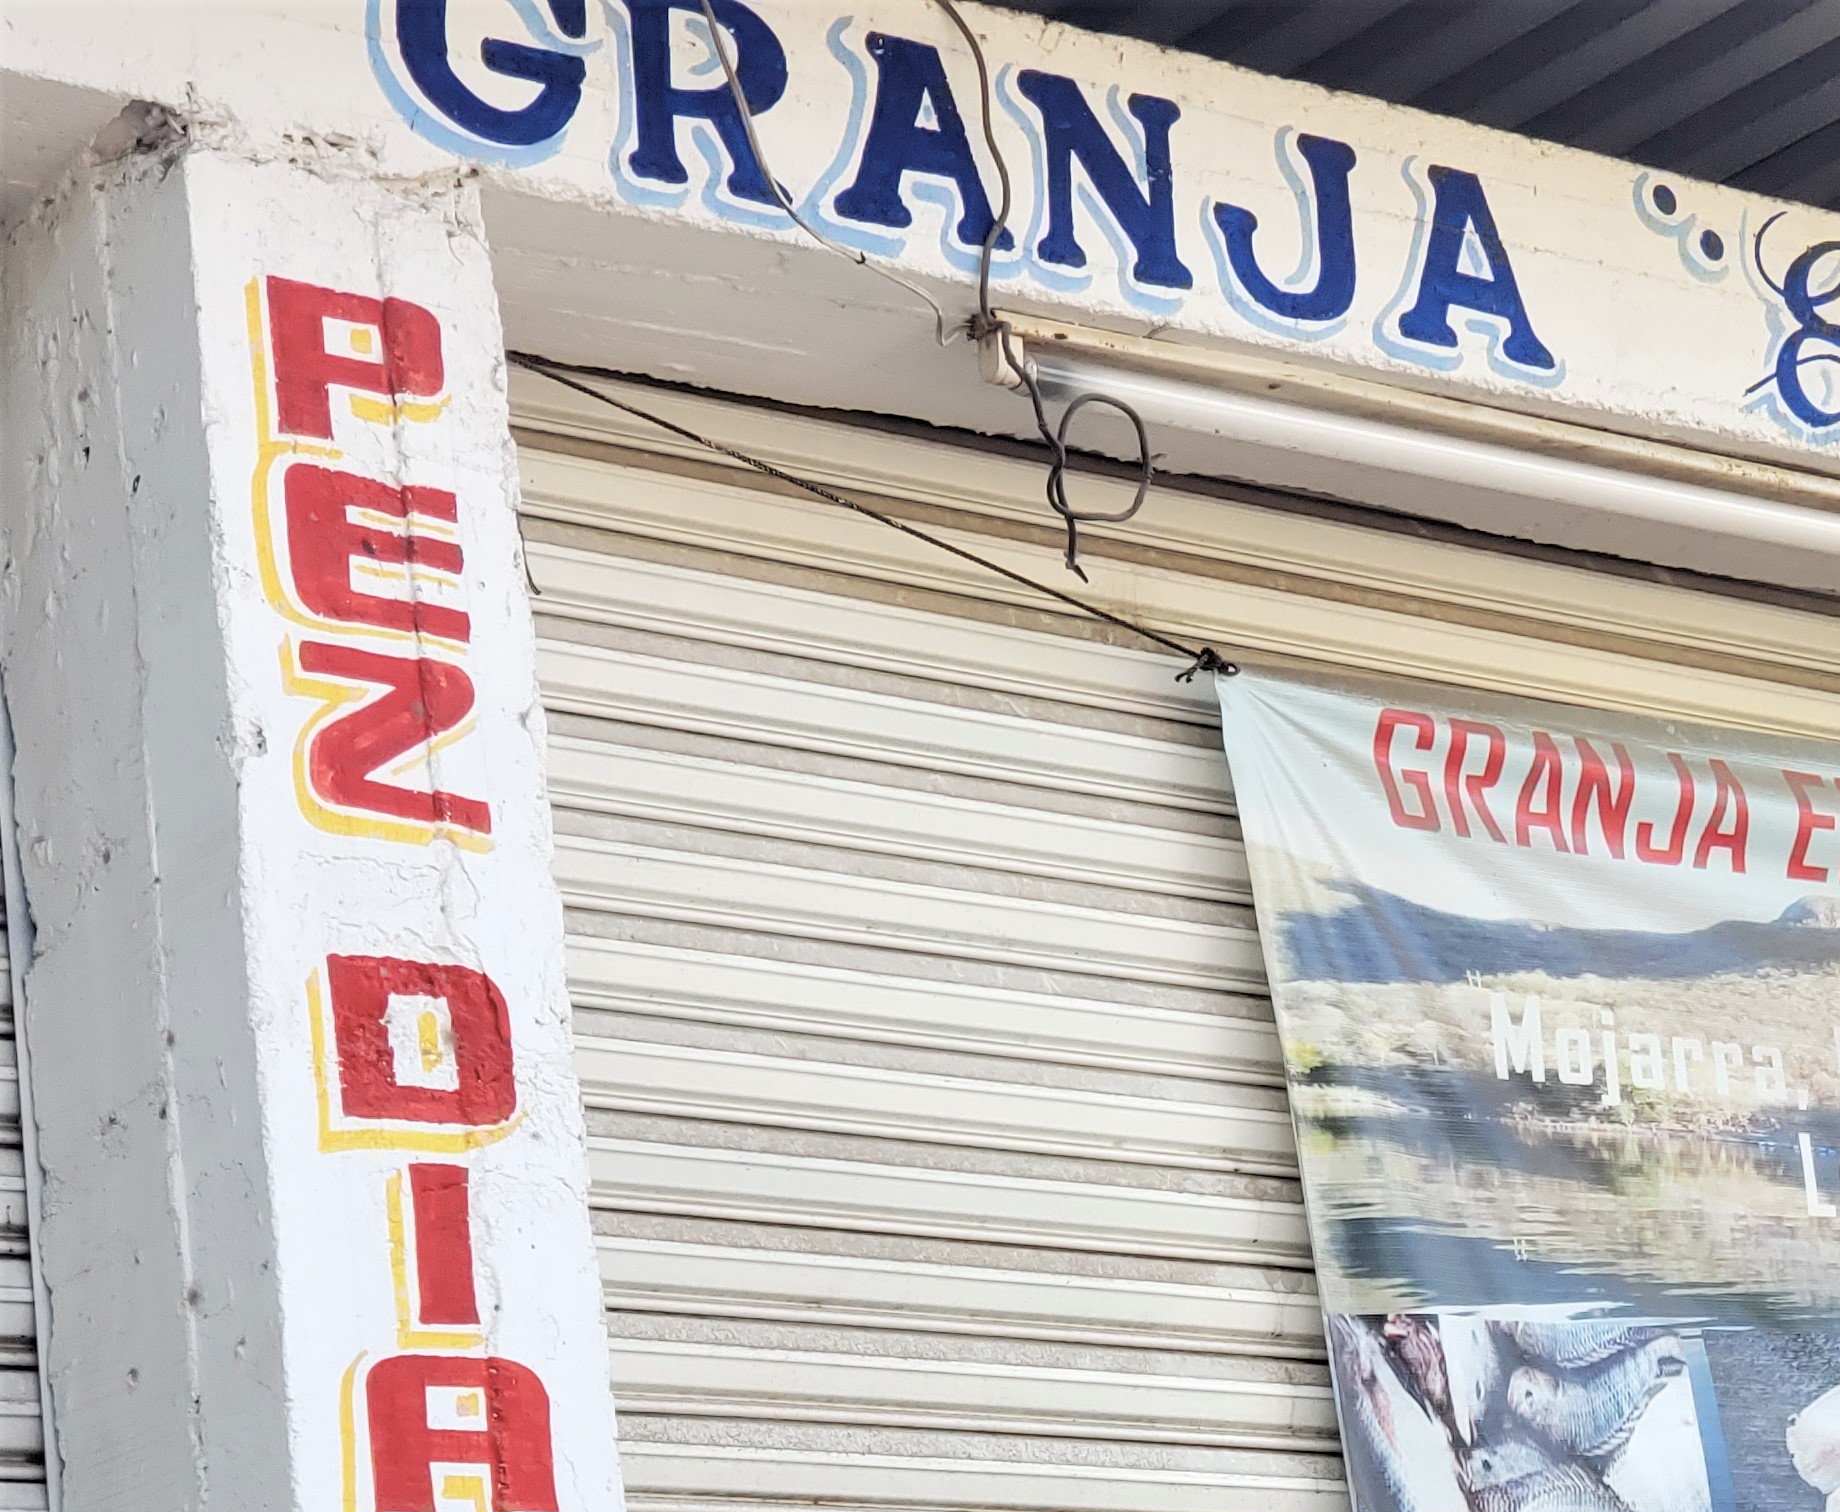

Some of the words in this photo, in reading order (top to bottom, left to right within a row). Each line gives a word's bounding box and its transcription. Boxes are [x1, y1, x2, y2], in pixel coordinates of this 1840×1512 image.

[390, 0, 1556, 370] GRANJA
[266, 274, 492, 835] PEZ
[1372, 707, 1751, 874] GRANJA
[1491, 998, 1809, 1112] Mojarra,
